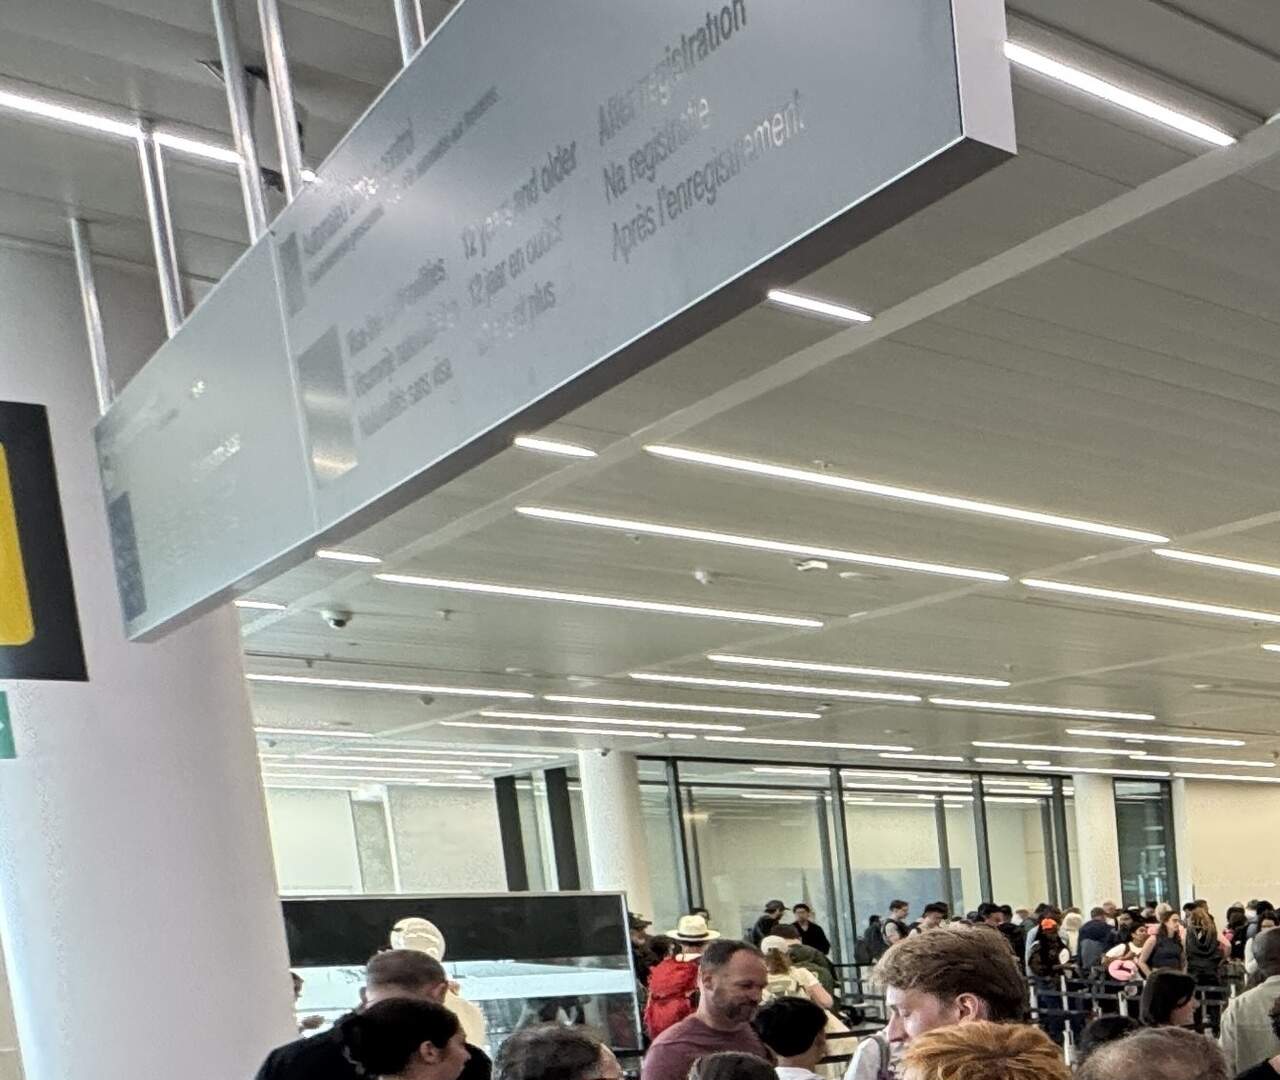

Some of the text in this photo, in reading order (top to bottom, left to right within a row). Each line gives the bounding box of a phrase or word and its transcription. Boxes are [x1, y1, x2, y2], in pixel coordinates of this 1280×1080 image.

[541, 140, 577, 194] older
[603, 160, 628, 204] Na
[611, 202, 657, 264] Après
